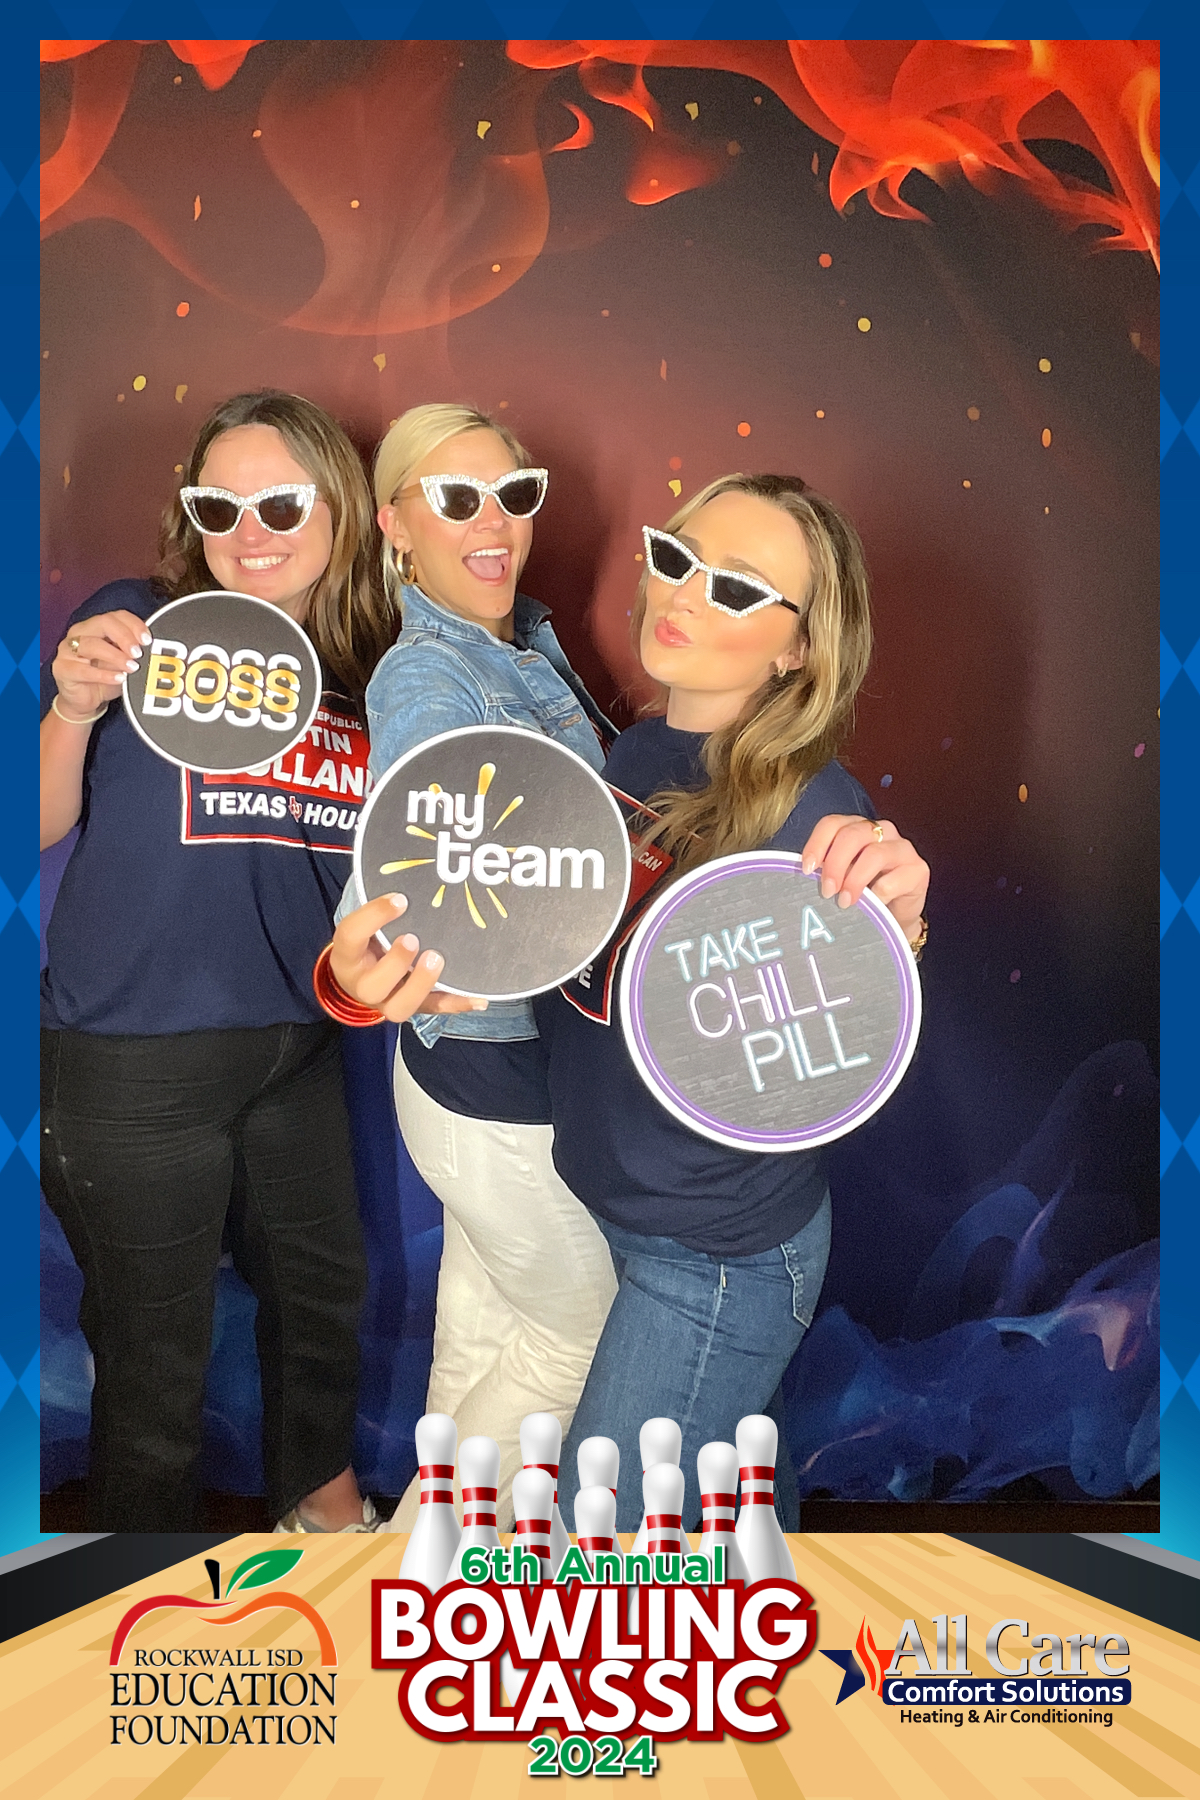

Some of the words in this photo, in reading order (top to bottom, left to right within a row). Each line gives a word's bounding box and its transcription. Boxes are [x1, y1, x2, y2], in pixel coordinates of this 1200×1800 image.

[145, 654, 300, 713] BOSS
[299, 725, 353, 755] TIN
[314, 711, 363, 731] EPUBLIC
[200, 791, 287, 819] TEXAS
[406, 789, 487, 840] my
[436, 831, 605, 890] team
[664, 916, 783, 983] TAKE
[800, 904, 836, 950] A
[688, 953, 852, 1039] CHILL
[741, 1011, 872, 1093] PILL
